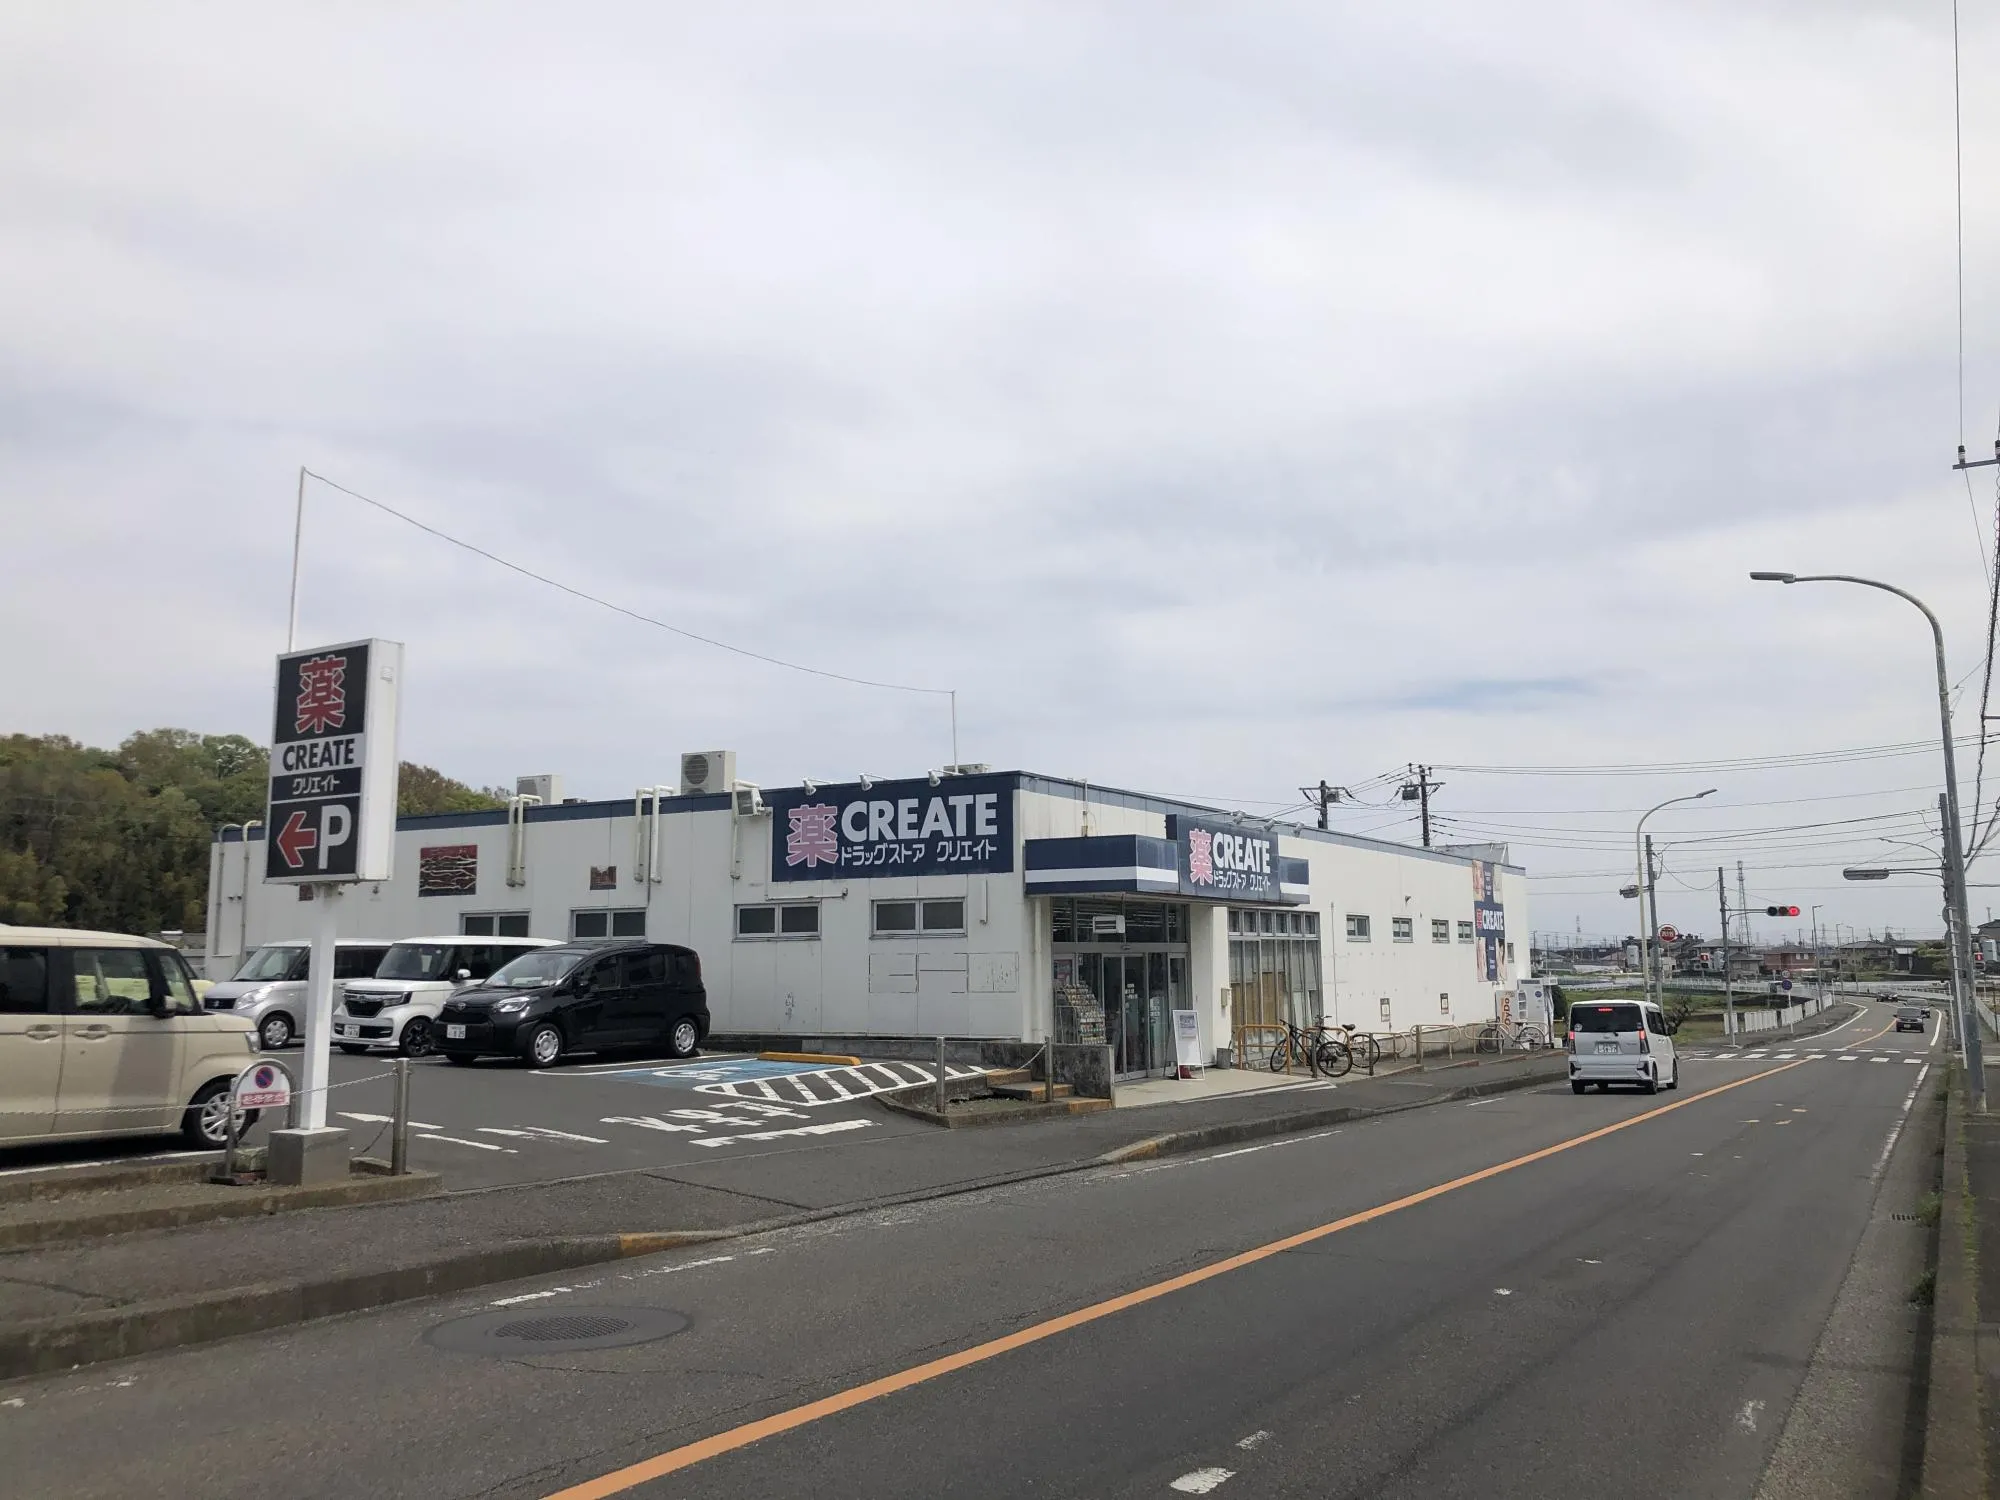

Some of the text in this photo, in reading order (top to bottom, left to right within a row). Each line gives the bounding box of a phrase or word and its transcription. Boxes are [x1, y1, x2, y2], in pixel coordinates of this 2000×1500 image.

[295, 654, 347, 734] 薬
[282, 738, 355, 771] CREATE
[292, 774, 340, 795] クリエイト
[318, 804, 352, 870] P
[786, 803, 839, 868] 薬
[841, 793, 998, 843] CREATE
[841, 839, 998, 867] ドラッグストア クリエイト
[1189, 828, 1213, 886] 薬
[1213, 832, 1271, 874] CREATE
[1213, 870, 1271, 892] ドラッグストア クリエイト
[1483, 910, 1504, 931] CREATE
